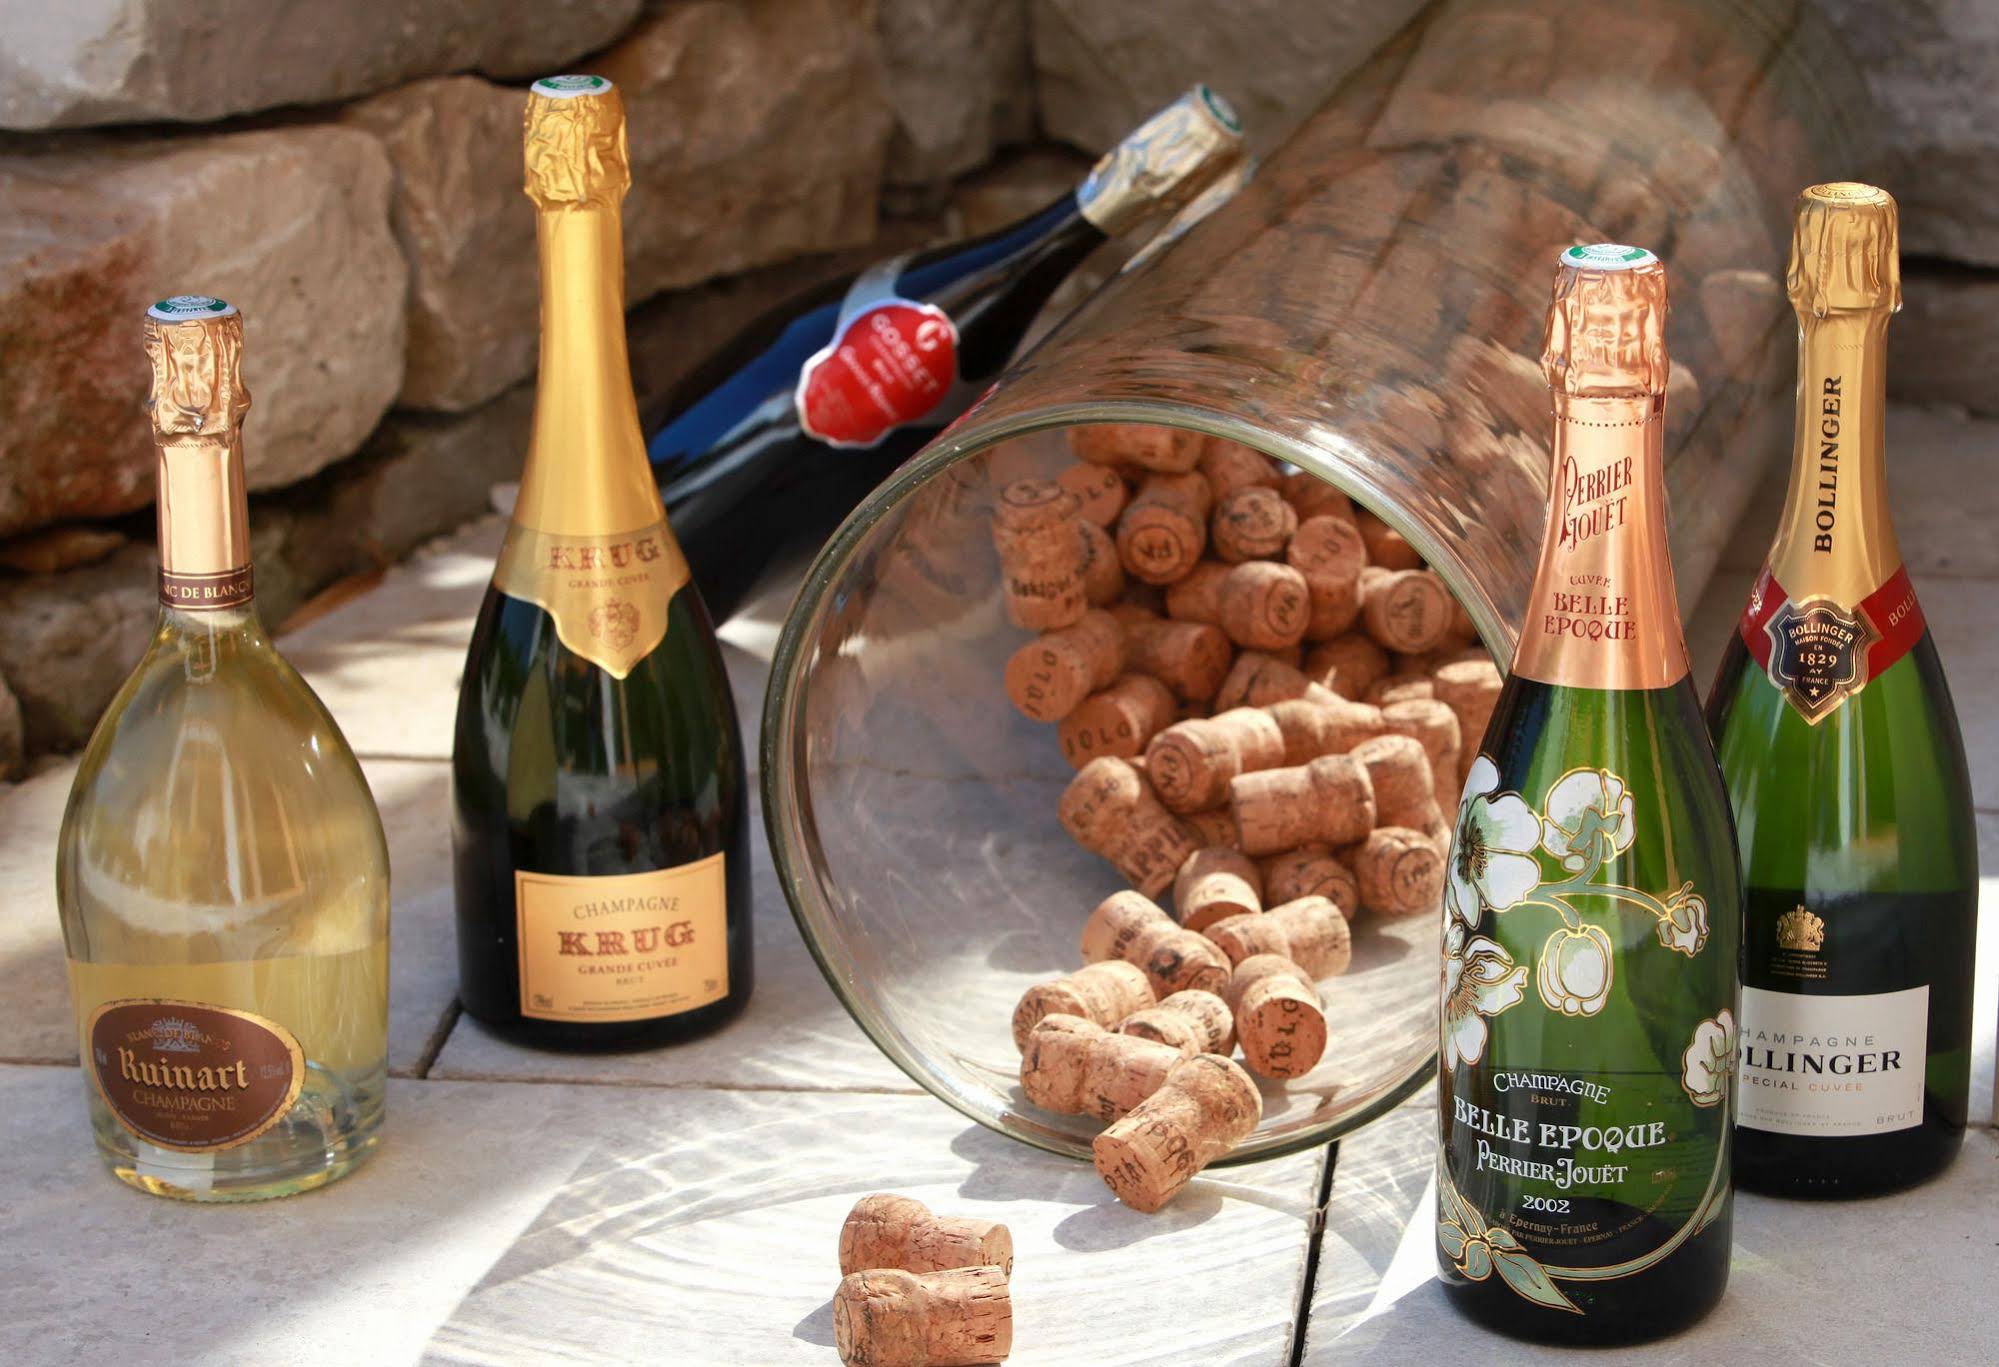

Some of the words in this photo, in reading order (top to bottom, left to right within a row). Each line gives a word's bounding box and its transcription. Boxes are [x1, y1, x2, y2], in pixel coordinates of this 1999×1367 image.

[1814, 376, 1842, 553] BOLLINGER
[1559, 456, 1632, 547] PERRIER
[550, 538, 660, 569] KRUG
[181, 587, 200, 599] DE
[1554, 592, 1629, 616] BELLE
[1544, 616, 1636, 642] EPOQUE
[1789, 623, 1853, 644] BOLLINGER
[1800, 653, 1837, 668] 1829
[1802, 676, 1829, 685] FRANCE
[574, 897, 680, 920] CHAMPAGNE
[557, 920, 695, 957] KRUG
[578, 963, 633, 976] GRANDE
[1740, 1026, 1875, 1047] HAMPAGNE
[118, 1046, 249, 1091] Ruinart
[1739, 1046, 1902, 1075] LLINGER
[1493, 1073, 1611, 1105] CHAMPAGNE
[1743, 1074, 1798, 1090] PECIAL
[133, 1089, 236, 1111] CHAMPAGNE
[1530, 1094, 1567, 1106] BRUT
[1454, 1095, 1530, 1144] BELLE
[1538, 1121, 1666, 1154] EPOQUE
[1876, 1109, 1914, 1125] BRUT
[1476, 1139, 1629, 1189] PERRIER-JOUËT
[1521, 1194, 1571, 1214] 2002
